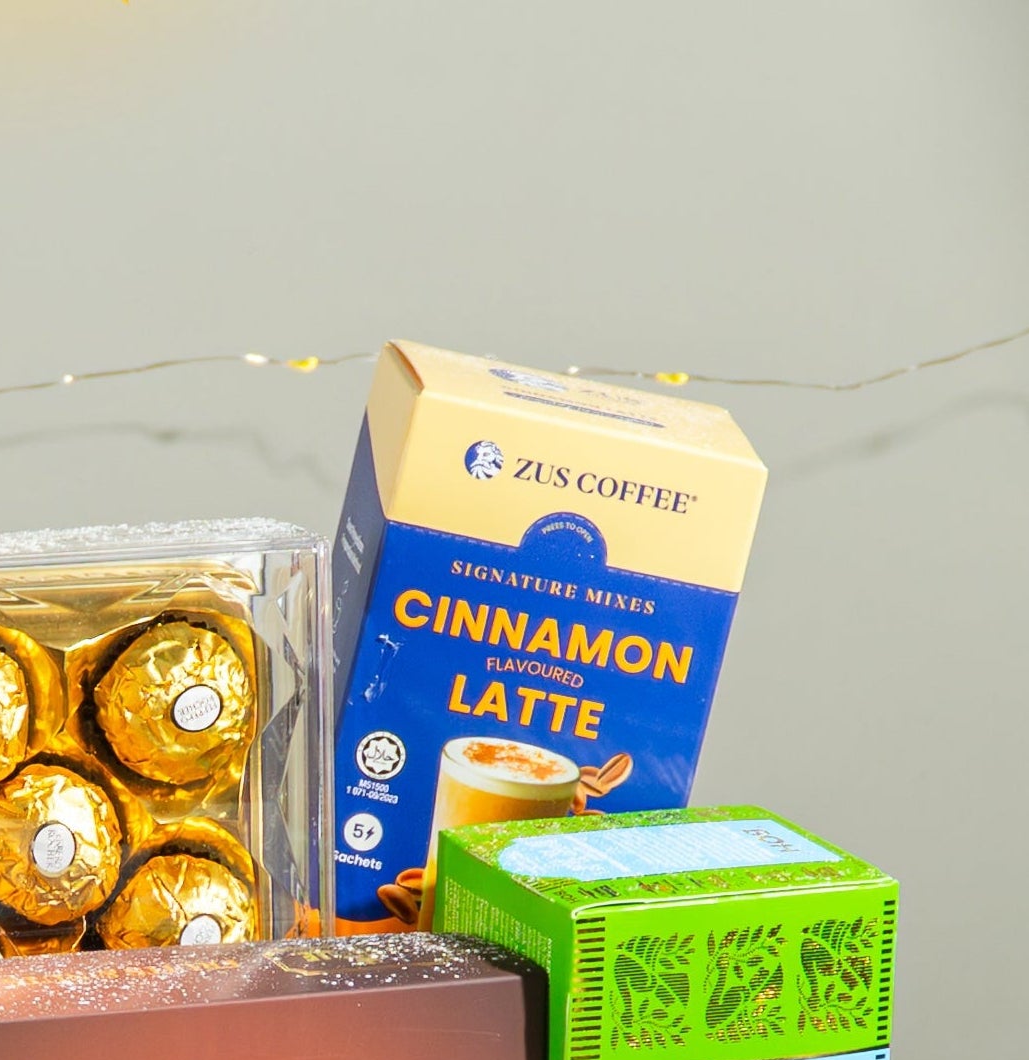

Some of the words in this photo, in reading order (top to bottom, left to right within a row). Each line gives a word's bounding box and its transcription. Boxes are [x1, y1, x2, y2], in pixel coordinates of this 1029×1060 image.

[513, 458, 570, 489] ZUS
[577, 472, 690, 514] COFFEE
[451, 560, 578, 599] SIGNATURE
[585, 588, 656, 615] MIXES
[394, 588, 694, 685] CINNAMON
[486, 657, 584, 689] FLAVOURED
[448, 674, 605, 740] LATTE
[352, 823, 364, 838] 5
